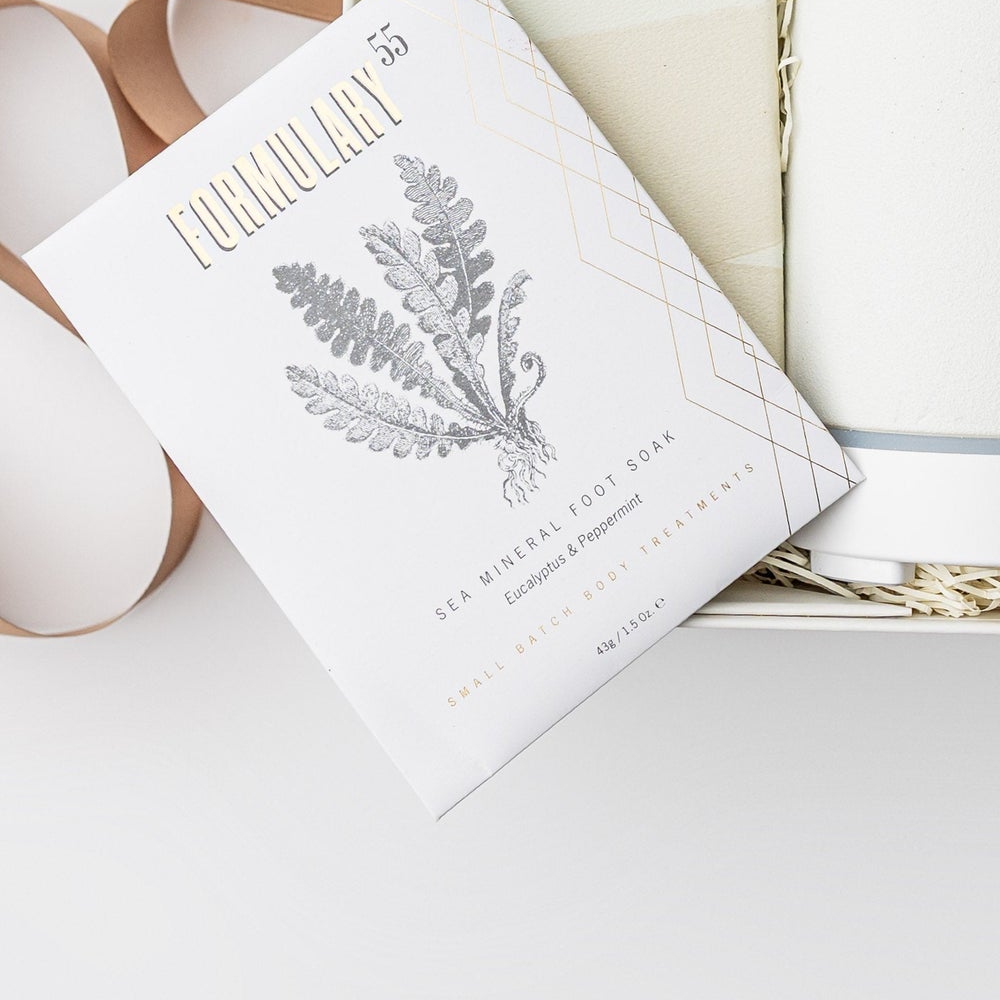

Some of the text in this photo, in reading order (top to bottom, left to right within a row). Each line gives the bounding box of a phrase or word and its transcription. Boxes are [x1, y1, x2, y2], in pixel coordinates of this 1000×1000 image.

[166, 22, 409, 270] FORMULARY 55
[435, 429, 676, 621] SEA MINERAL FOOT SOAK
[447, 463, 754, 709] SMALL BATCH BODY TREATMENTS
[504, 492, 644, 606] Eucalyptus & Peppermint
[596, 639, 617, 655] 43g
[621, 619, 639, 635] 1.5
